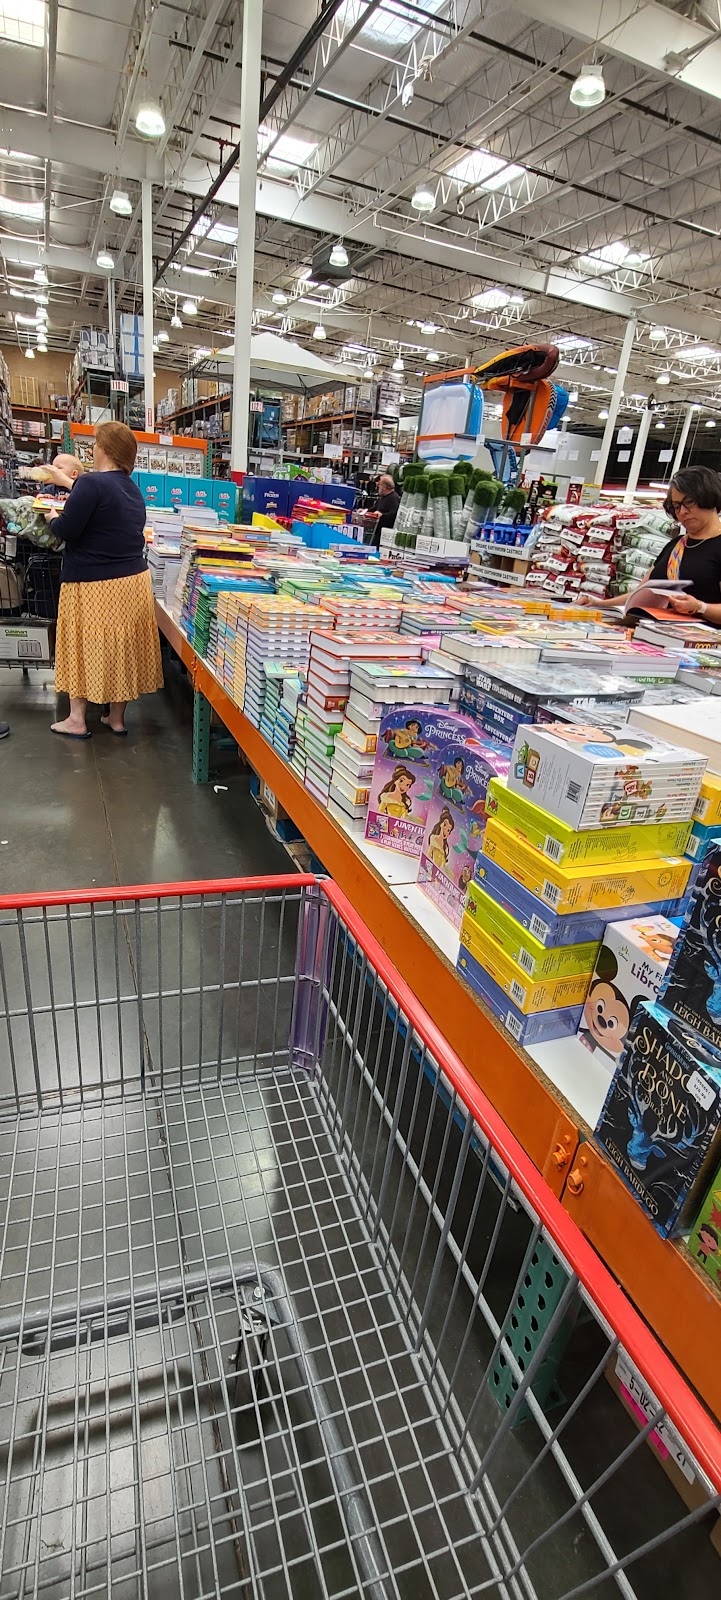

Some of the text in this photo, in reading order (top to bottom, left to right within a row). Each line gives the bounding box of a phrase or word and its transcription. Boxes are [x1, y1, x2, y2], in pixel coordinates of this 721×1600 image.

[488, 544, 506, 553] EARTHWORM
[506, 547, 522, 555] CASTINGS
[502, 573, 518, 581] CASTINGS
[476, 674, 491, 685] STAR
[476, 681, 491, 691] WARS
[568, 697, 596, 709] STAR
[486, 701, 514, 721] ADVENTURE
[494, 713, 504, 724] BOX
[436, 719, 459, 733] Disney
[484, 723, 512, 743] ADVENTURE
[475, 760, 489, 779] Disney
[641, 961, 653, 974] My
[673, 1002, 701, 1029] LEIGH
[635, 1027, 692, 1093] SHADO
[638, 1062, 687, 1124] BONE
[605, 1138, 658, 1215] LEIGH BARDUGO
